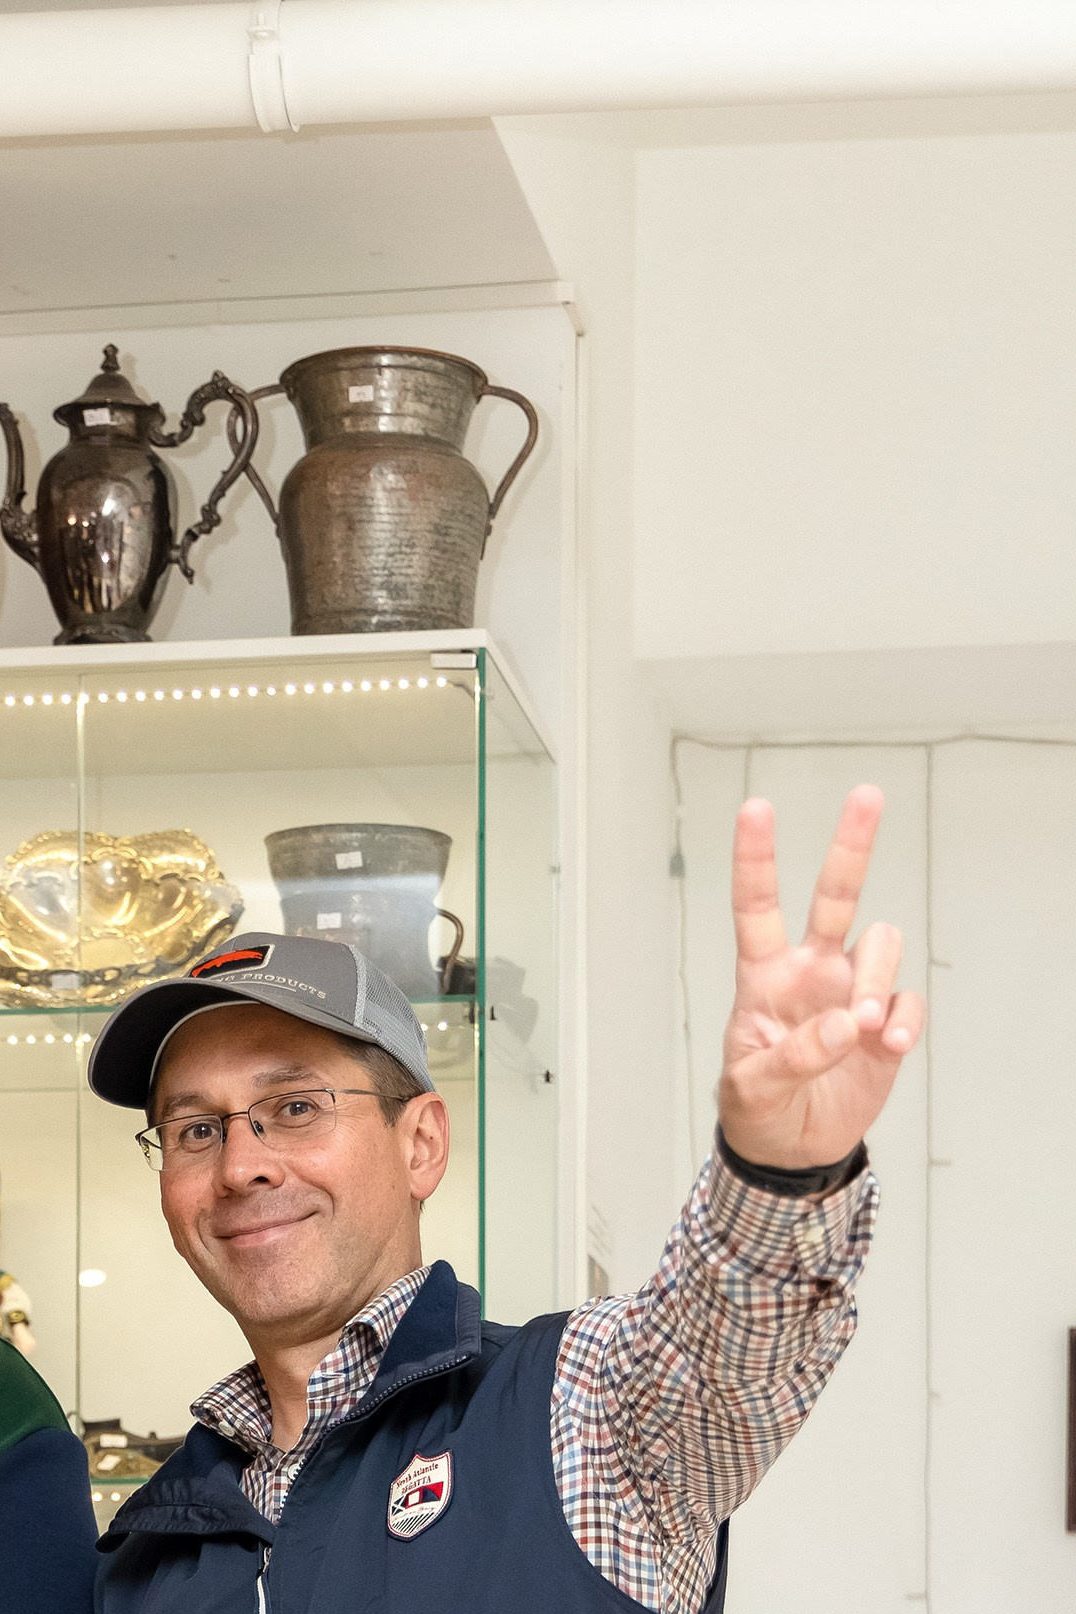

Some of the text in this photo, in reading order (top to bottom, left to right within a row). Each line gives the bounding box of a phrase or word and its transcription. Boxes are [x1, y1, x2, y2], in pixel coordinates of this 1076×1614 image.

[241, 973, 327, 999] PRODUCTS
[396, 1463, 439, 1489] North Atlantic
[401, 1475, 432, 1494] REGATTA
